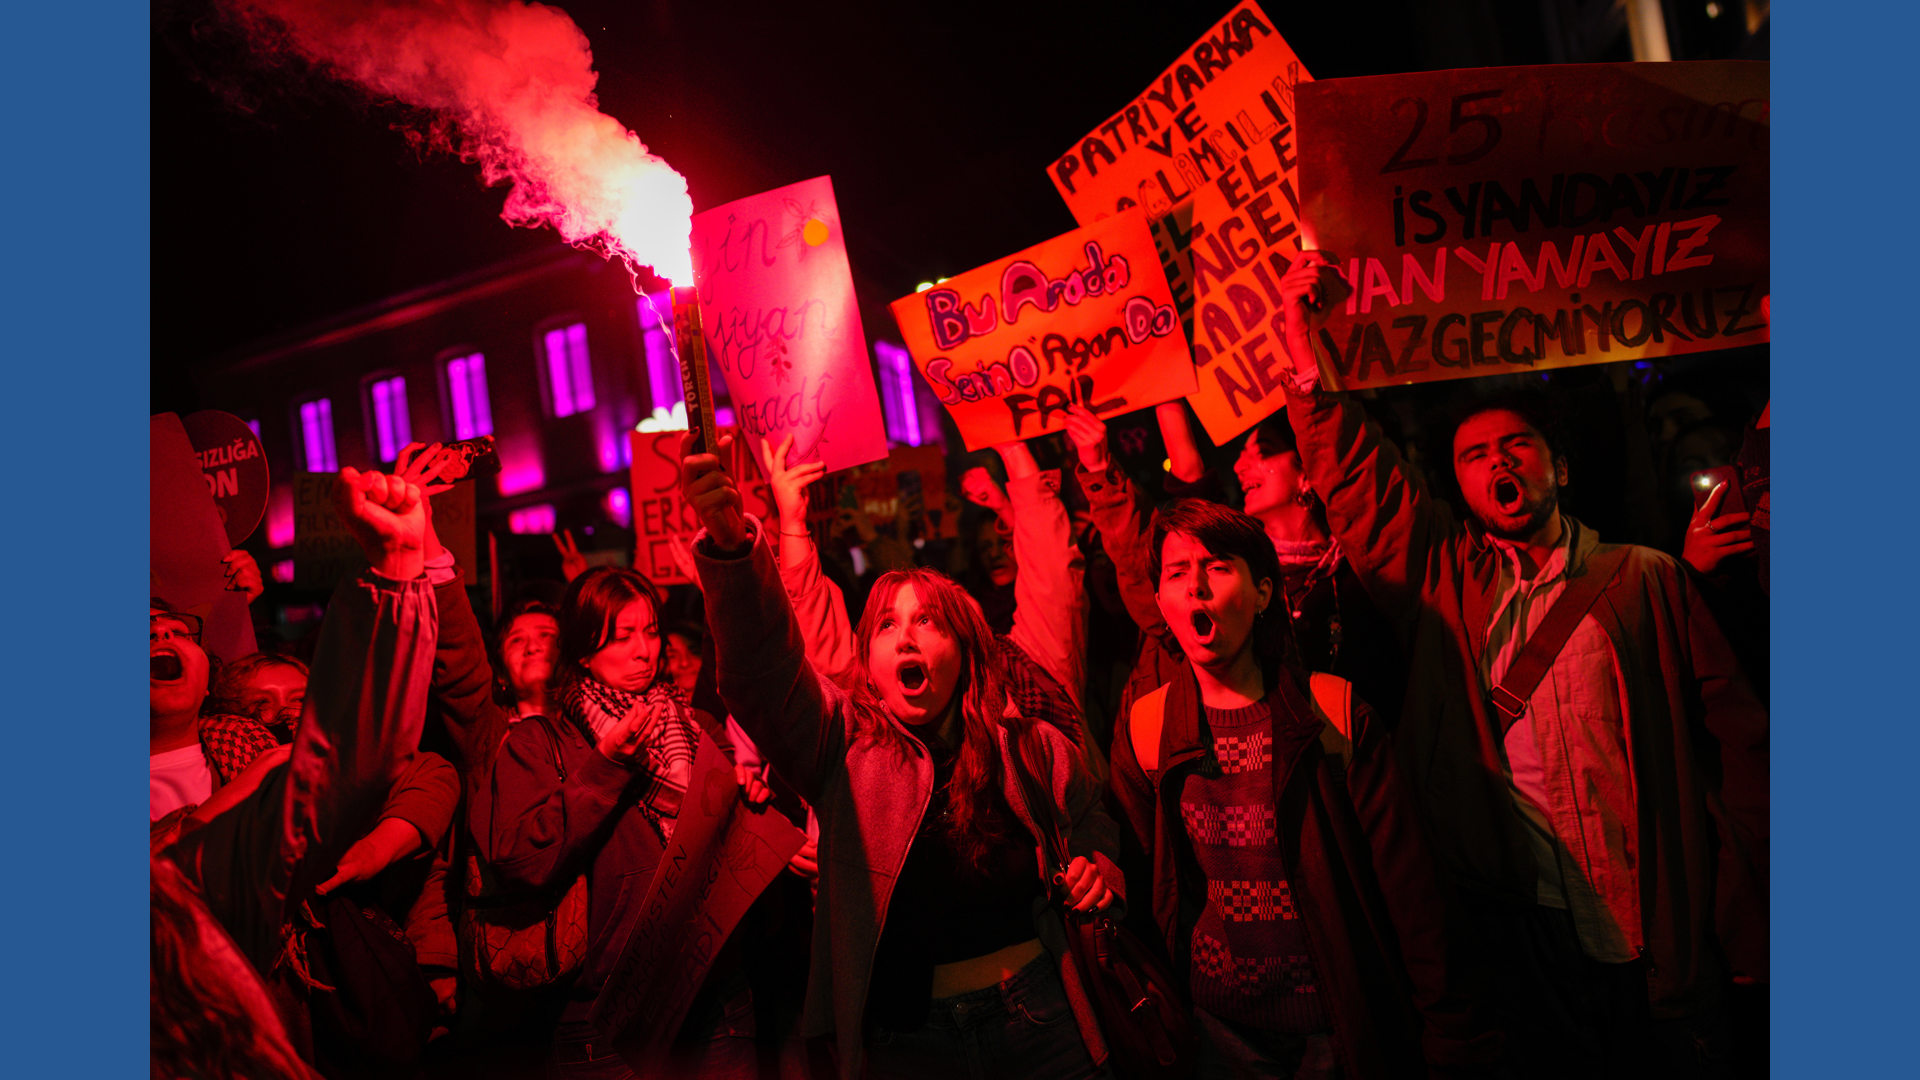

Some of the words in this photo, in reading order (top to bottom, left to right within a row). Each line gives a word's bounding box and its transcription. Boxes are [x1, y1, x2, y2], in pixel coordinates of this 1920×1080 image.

[1145, 101, 1208, 158] VE
[1379, 88, 1504, 176] 25
[1393, 165, 1739, 247] İSYANDAYIZ
[926, 288, 998, 350] Bu
[1001, 240, 1131, 325] Arada
[1453, 213, 1722, 302] YANAYIZ
[1124, 295, 1177, 345] Da
[680, 360, 699, 413] TORCH
